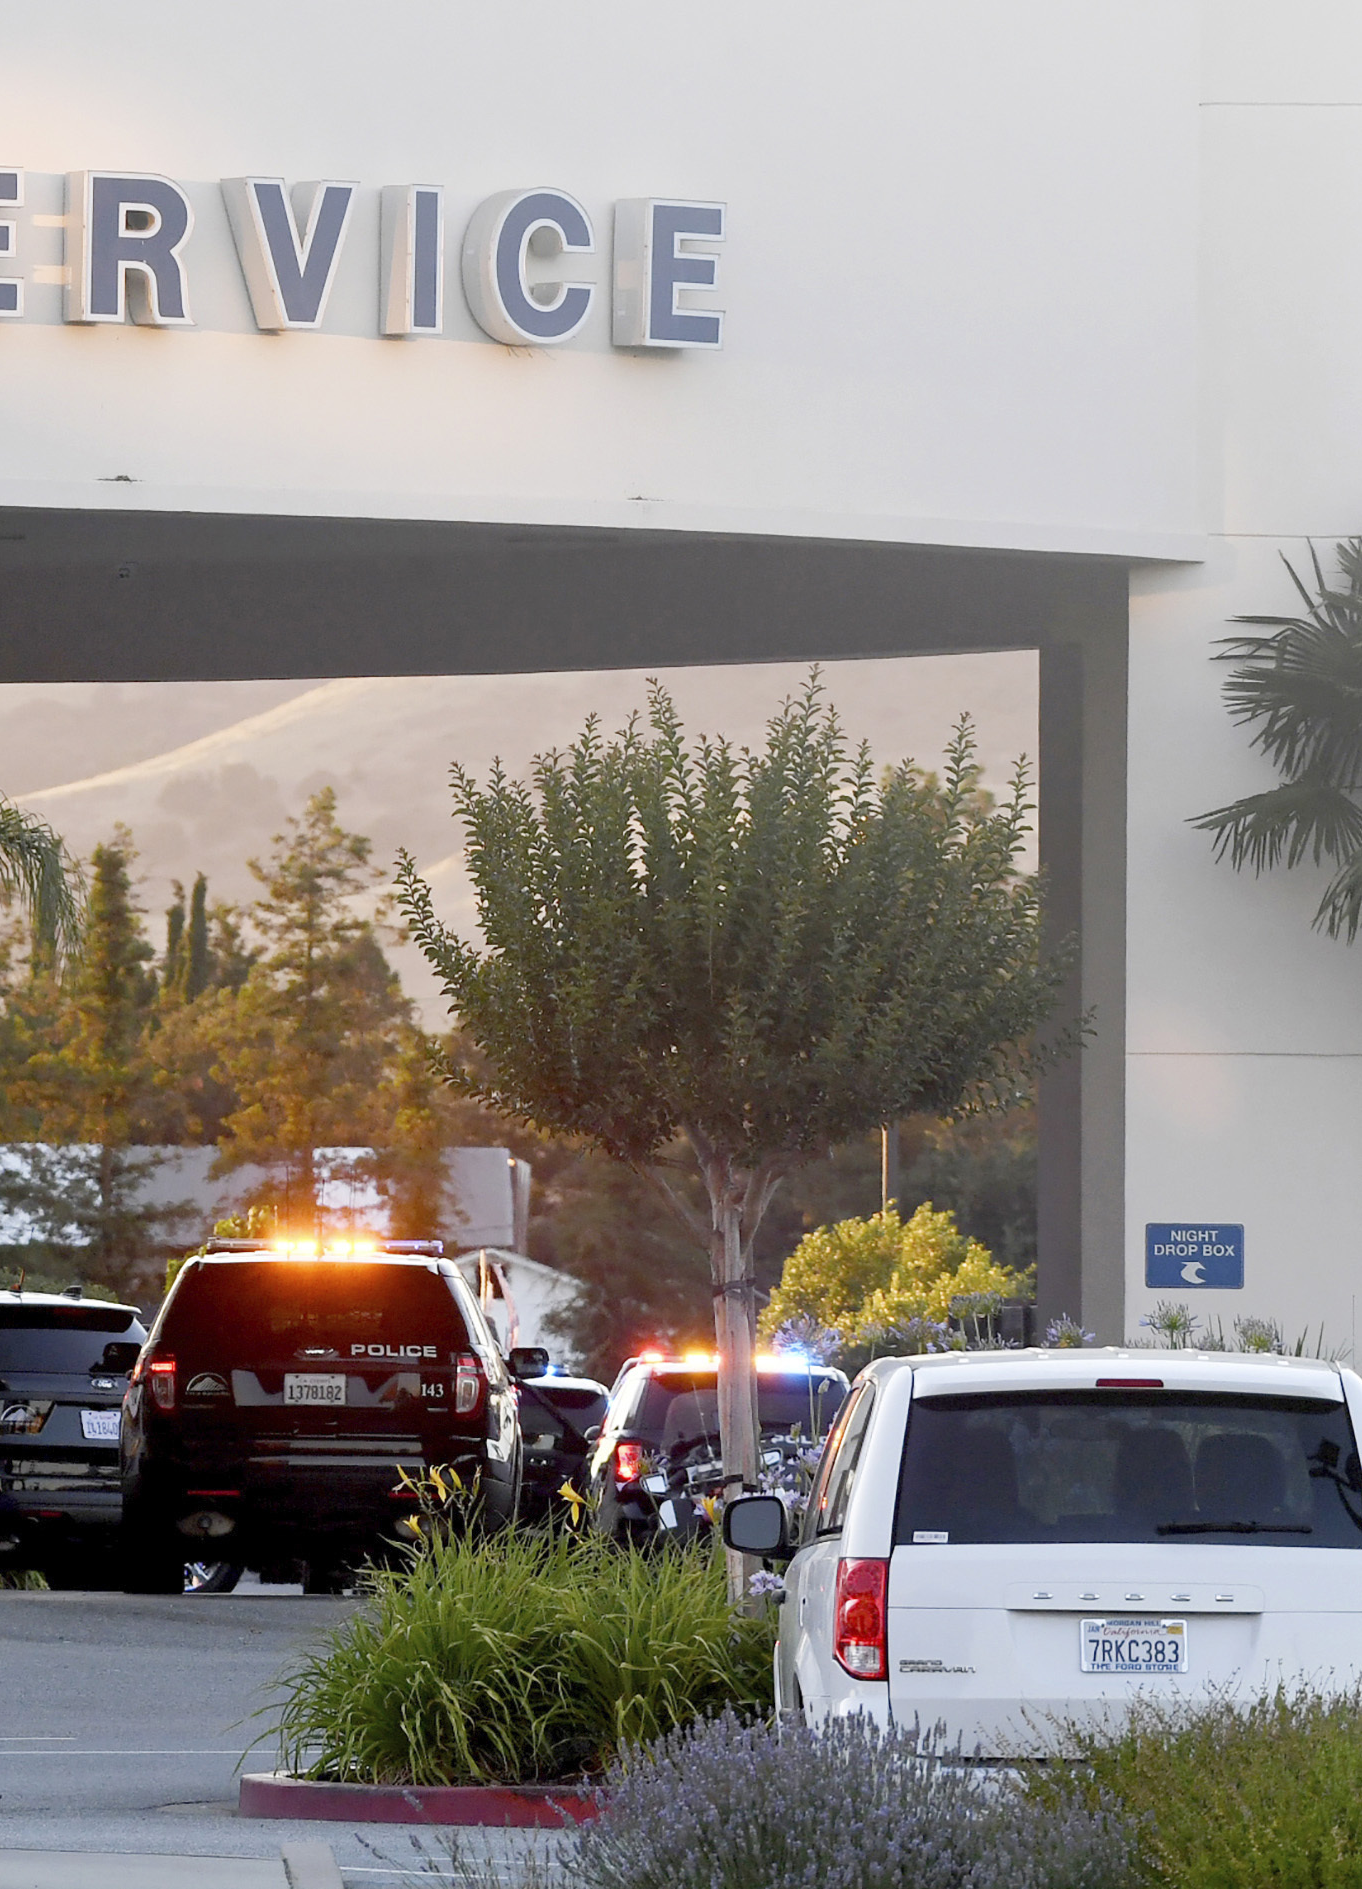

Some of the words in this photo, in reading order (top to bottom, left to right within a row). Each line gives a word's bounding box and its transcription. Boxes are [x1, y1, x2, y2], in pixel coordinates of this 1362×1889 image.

[1170, 1230, 1219, 1242] NIGHT
[1154, 1244, 1198, 1256] DROP
[1202, 1244, 1235, 1256] BOX
[351, 1344, 438, 1358] POLICE
[288, 1385, 342, 1400] 1378182
[421, 1383, 444, 1397] 143
[1032, 1592, 1234, 1602] DODGE
[1087, 1625, 1100, 1633] JAN
[1103, 1627, 1165, 1639] California
[1088, 1640, 1179, 1663] 7RKC383
[1091, 1663, 1111, 1671] THE
[1115, 1663, 1142, 1671] FORD
[1145, 1663, 1178, 1671] STORE
